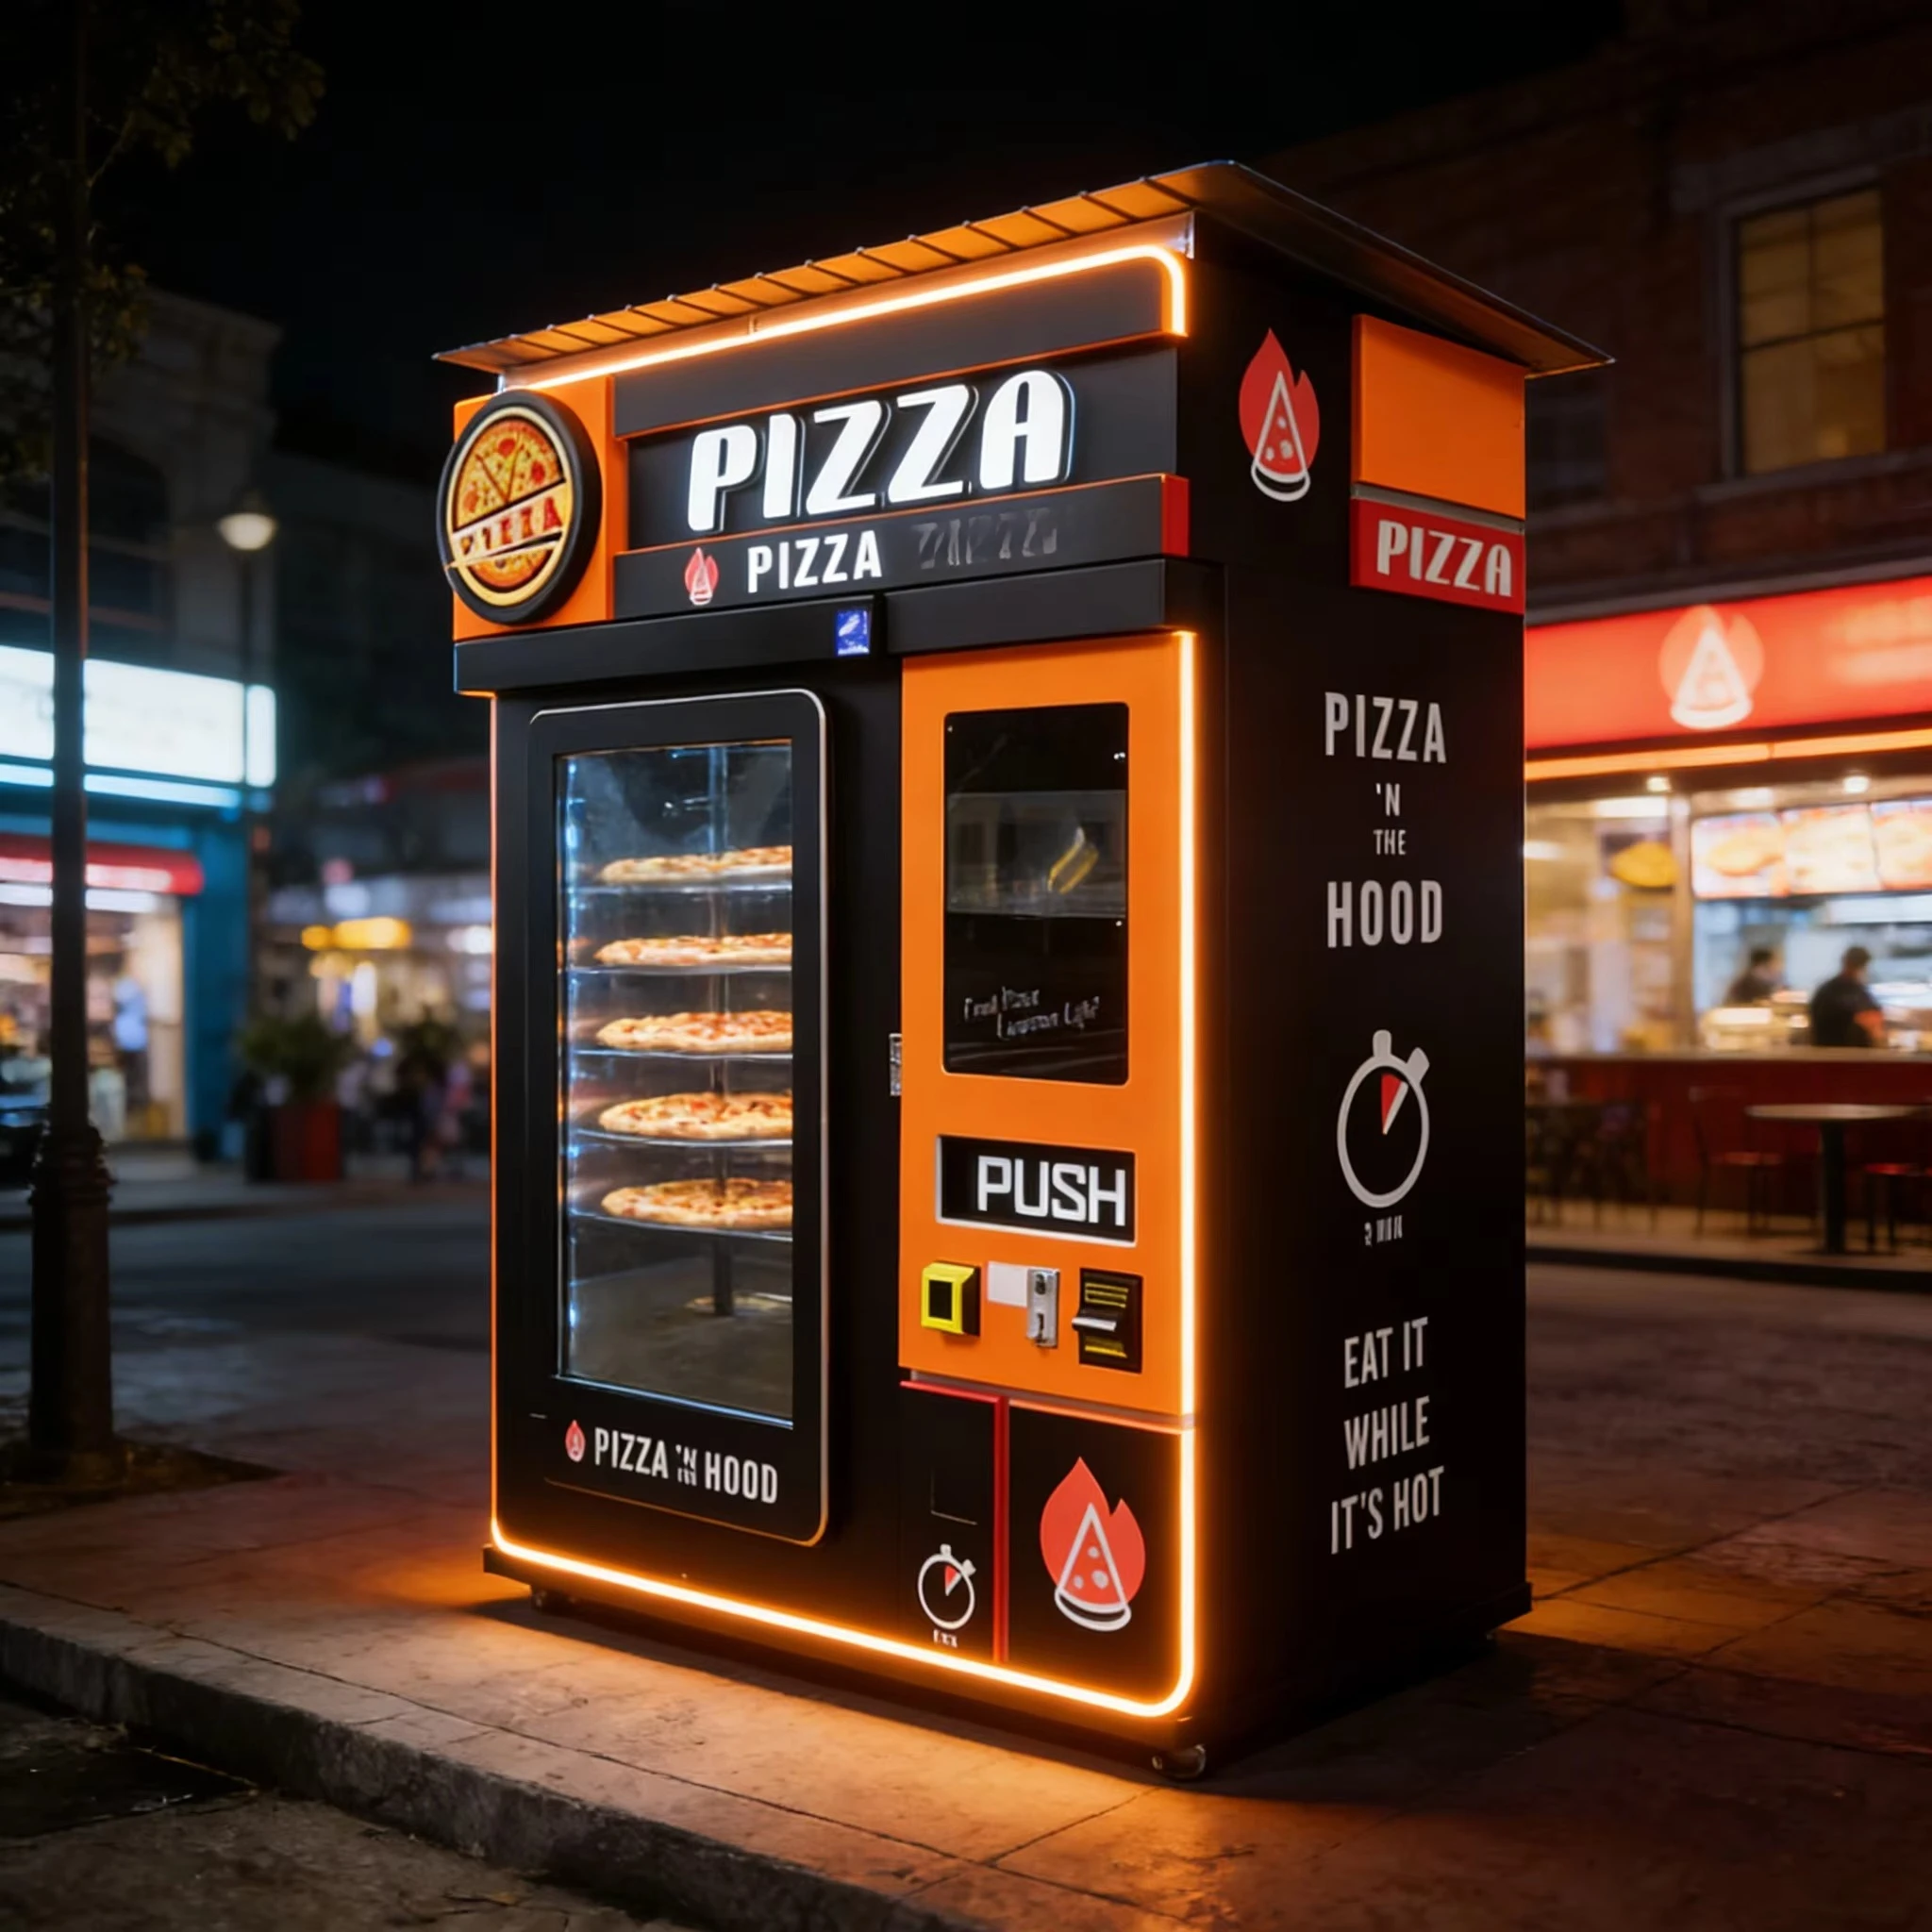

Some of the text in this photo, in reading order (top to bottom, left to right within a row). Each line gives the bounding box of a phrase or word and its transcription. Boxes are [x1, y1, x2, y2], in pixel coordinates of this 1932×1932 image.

[688, 370, 1073, 532] PIZZA
[747, 530, 882, 593] PIZZA
[1377, 520, 1511, 597] PIZZA
[1324, 691, 1446, 763] PIZZA
[1375, 783, 1400, 816] 'N
[1373, 829, 1406, 855] THE
[1327, 880, 1442, 948] HOOD
[977, 1155, 1126, 1226] PUSH
[1344, 1316, 1428, 1389] EAT IT
[594, 1426, 669, 1479] PIZZA
[705, 1450, 778, 1505] HOOD
[1343, 1395, 1430, 1470] WHILE
[1331, 1465, 1444, 1555] IT'S HOT
